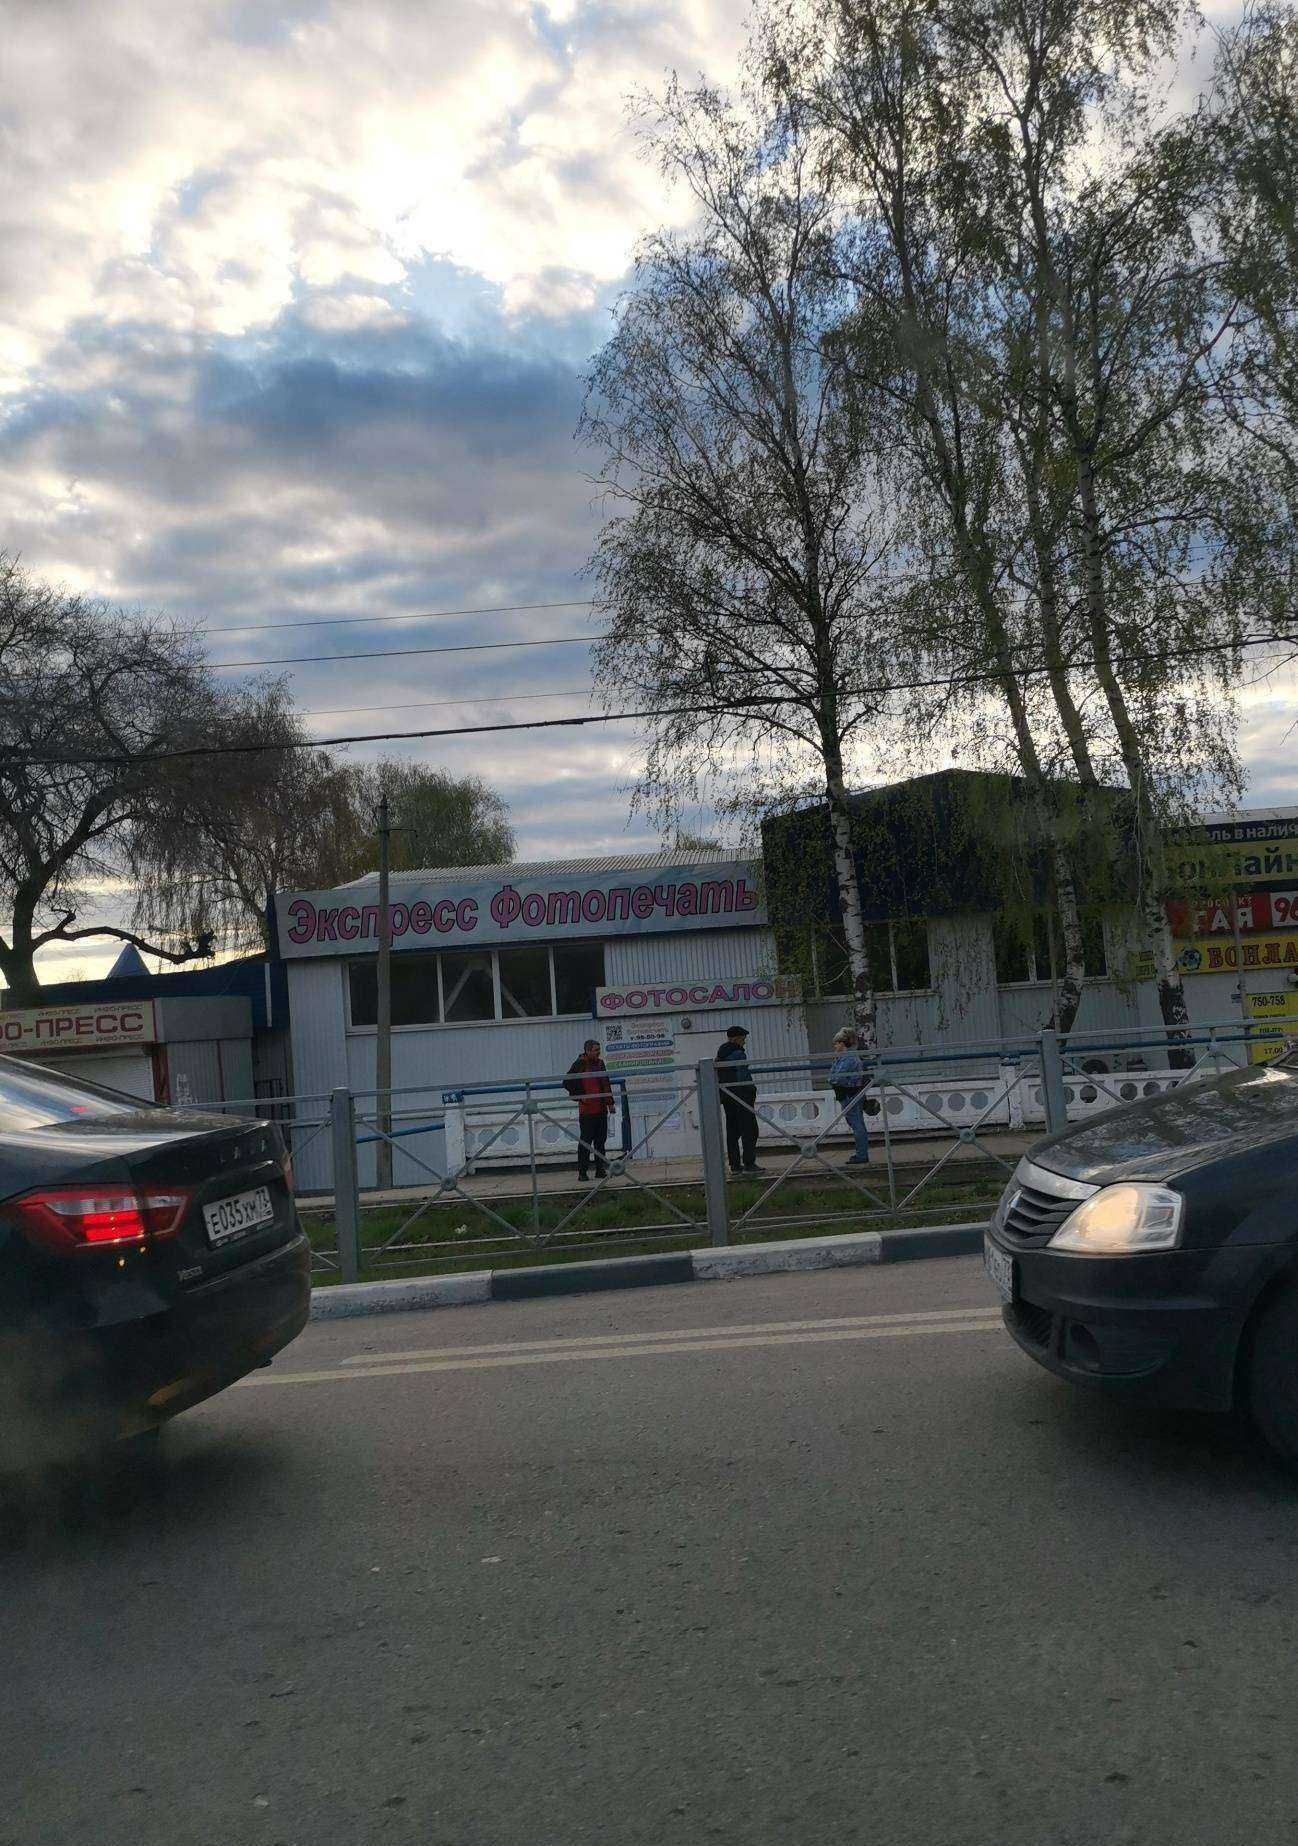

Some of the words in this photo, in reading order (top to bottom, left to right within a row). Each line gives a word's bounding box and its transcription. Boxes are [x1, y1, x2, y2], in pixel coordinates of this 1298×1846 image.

[287, 898, 478, 944] Экспресс
[490, 879, 757, 928] Фотопечать
[600, 979, 800, 1010] ФОТОСАЛОН
[0, 1012, 144, 1041] О-ПРЕСС
